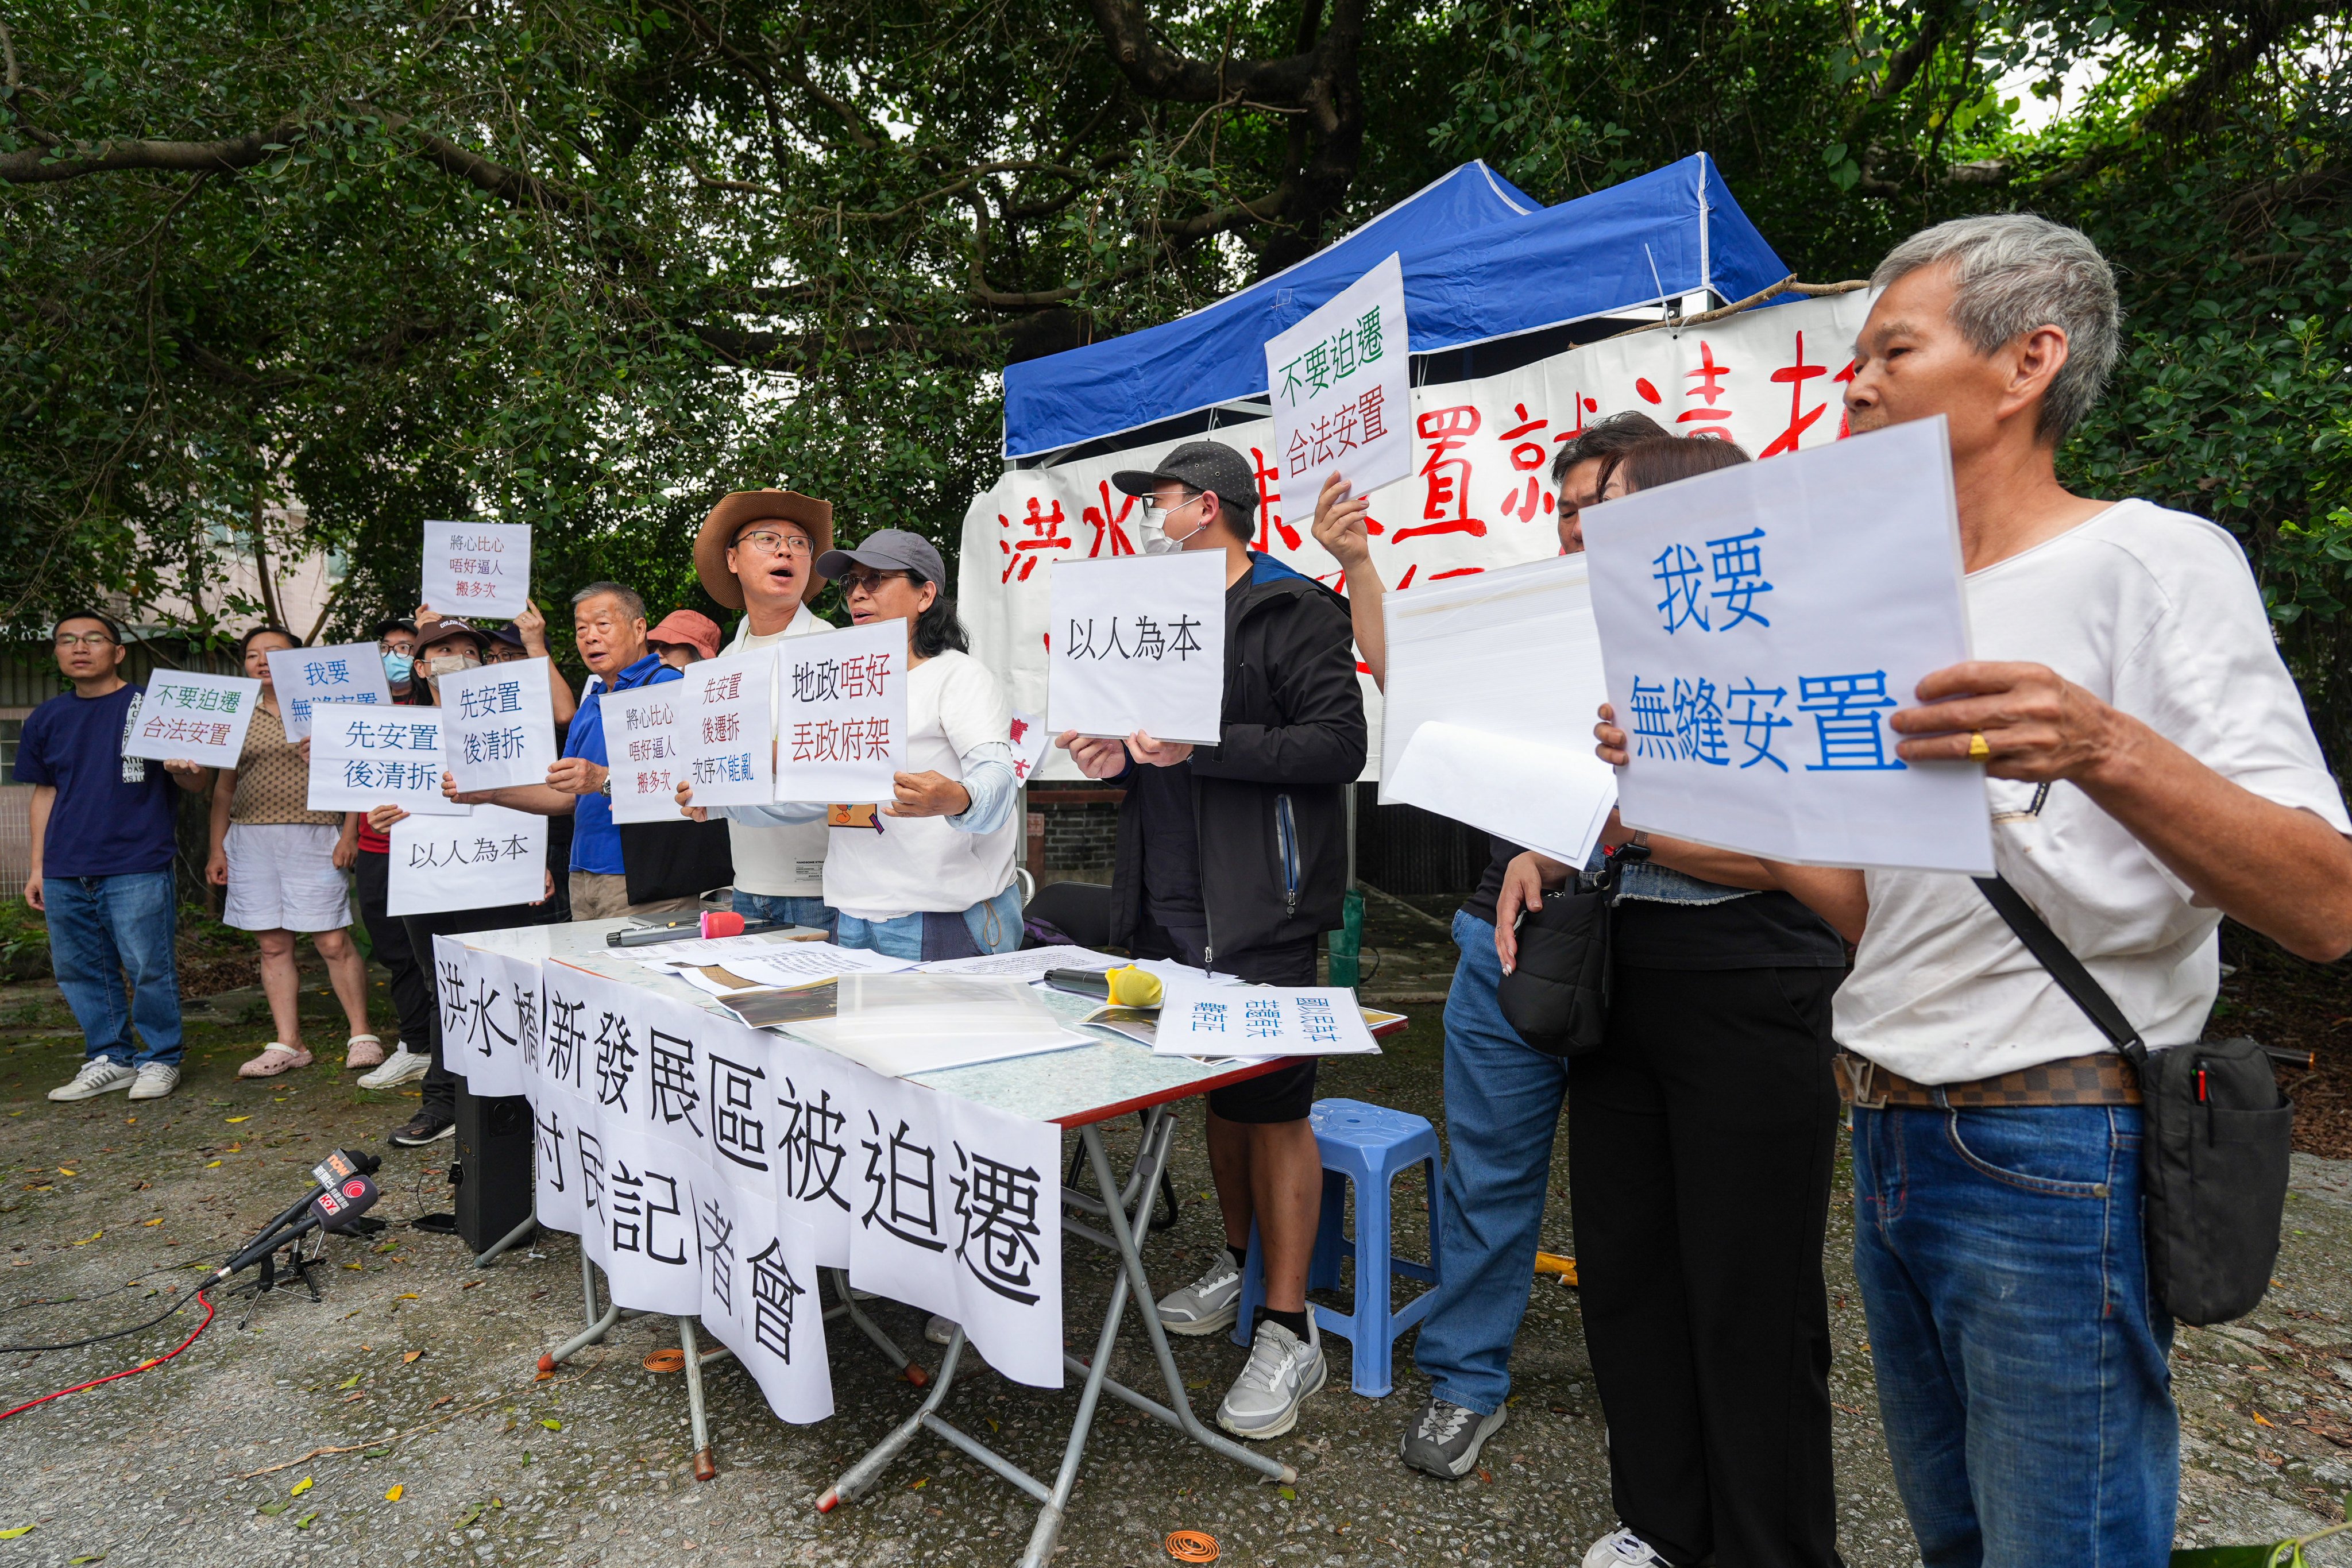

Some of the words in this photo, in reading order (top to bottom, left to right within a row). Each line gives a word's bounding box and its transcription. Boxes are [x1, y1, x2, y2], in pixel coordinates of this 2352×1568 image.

[1279, 305, 1383, 407] 不要迫遷
[1287, 384, 1388, 478] 合法安置
[450, 535, 504, 552] 將心比心
[450, 559, 503, 574] 唔好逼人
[1652, 527, 1774, 635] 我要
[457, 581, 495, 597] 搬多次
[1067, 614, 1202, 661] 以人為本
[304, 659, 349, 686] 我要
[792, 653, 890, 702] 地政唔好
[155, 685, 241, 713] 不要迫遷
[460, 681, 522, 720] 先安置
[703, 673, 742, 704] 先安置
[144, 716, 230, 746] 合法安置
[627, 703, 673, 730] 將心比心
[702, 713, 739, 744] 後遷拆
[1631, 670, 1909, 773] 無縫安置
[345, 721, 438, 750] 先安置
[464, 727, 524, 764] 後清拆
[629, 735, 675, 762] 唔好逼人
[791, 717, 889, 762] 丟政府架
[344, 760, 437, 790] 後清拆
[637, 769, 670, 793] 搬多次
[693, 753, 754, 785] 次序不能亂
[409, 835, 528, 868] 以人為本
[1295, 998, 1342, 1042] 國以民為本
[439, 960, 1041, 1307] 洪水橋新發展區被迫遷
[312, 1165, 336, 1189] 新聞台
[326, 1154, 350, 1177] now
[319, 1195, 337, 1210] HOY
[536, 1096, 806, 1366] 村民記者會
